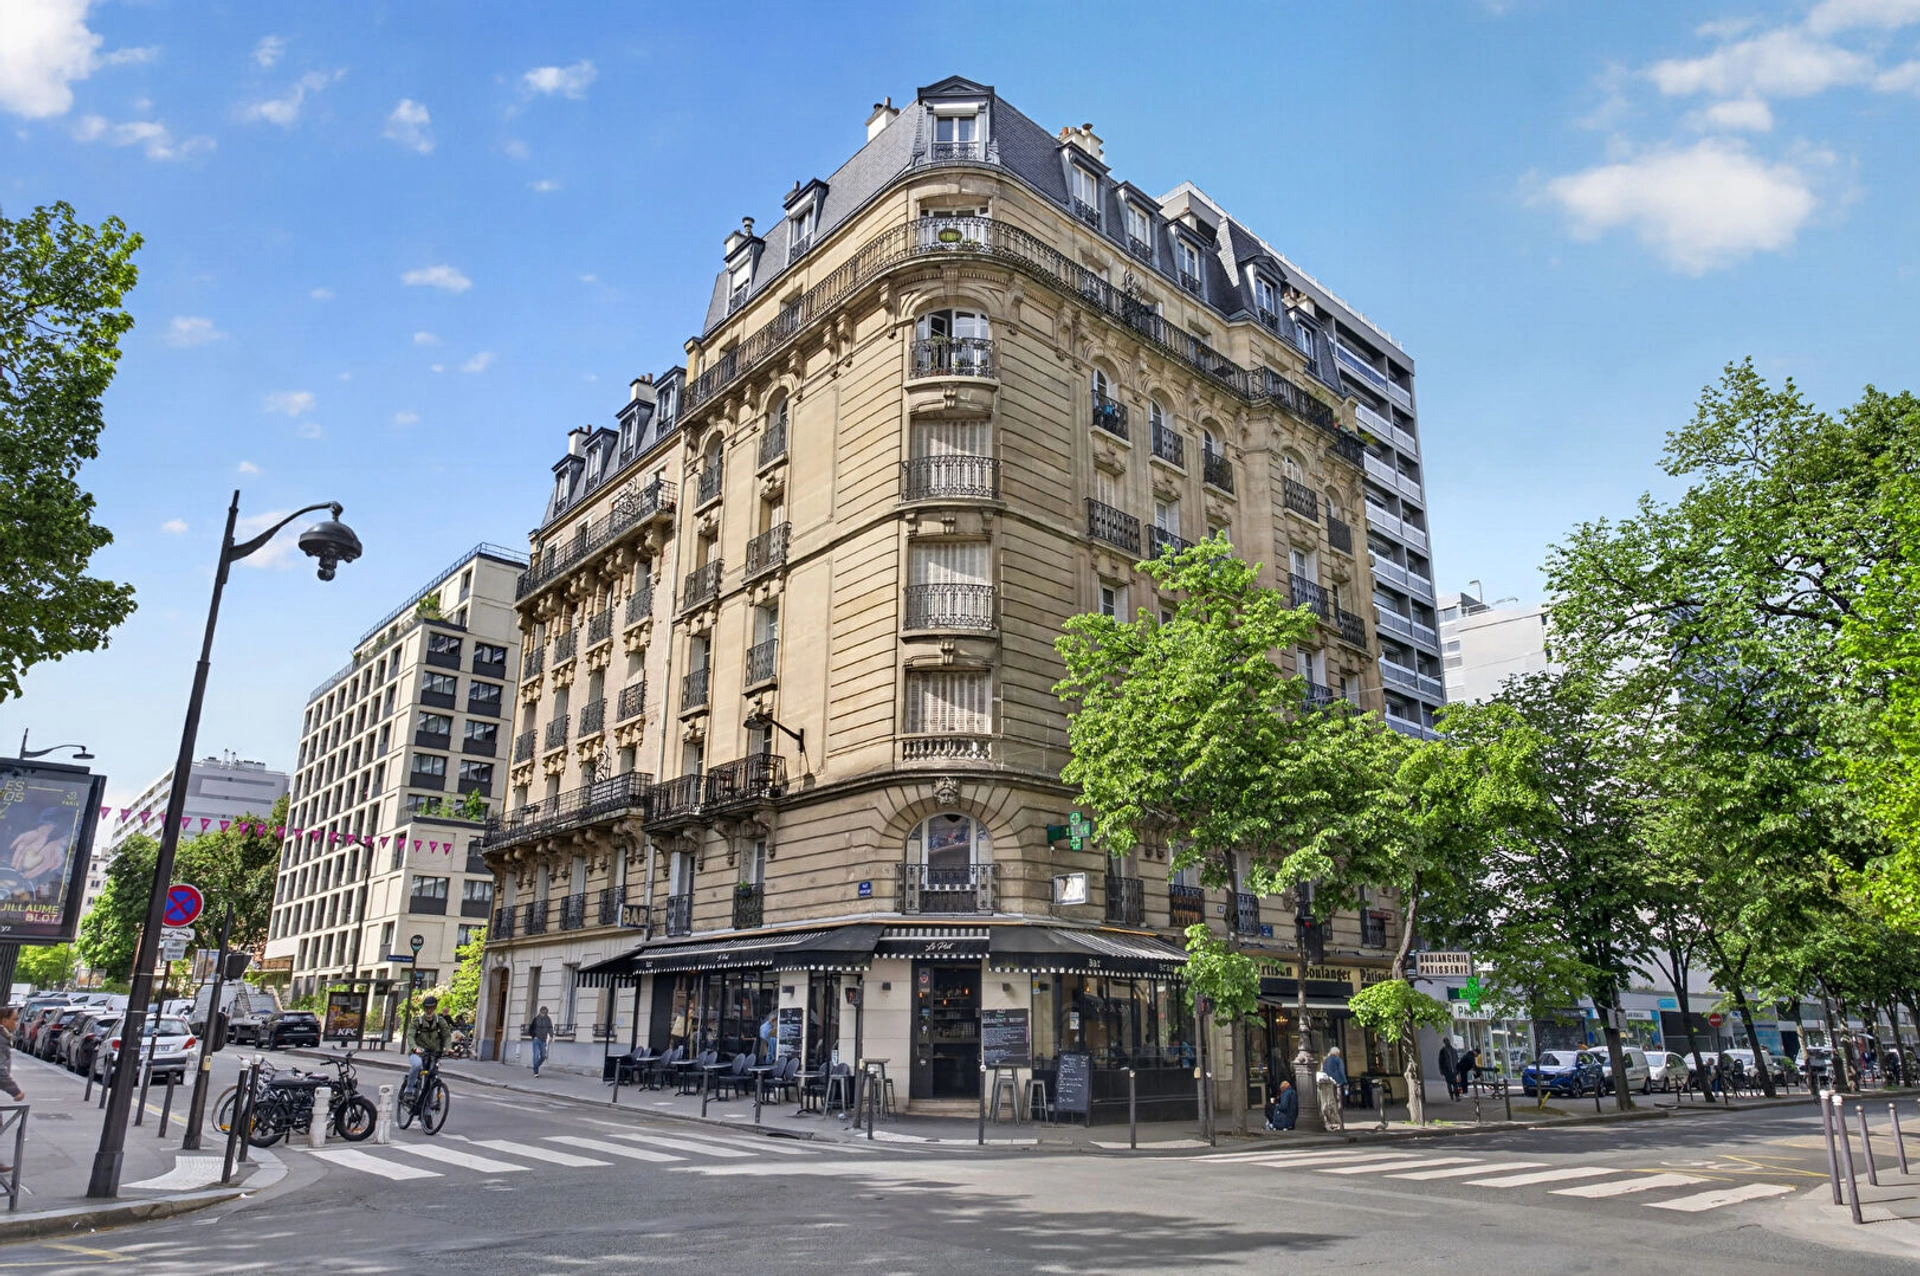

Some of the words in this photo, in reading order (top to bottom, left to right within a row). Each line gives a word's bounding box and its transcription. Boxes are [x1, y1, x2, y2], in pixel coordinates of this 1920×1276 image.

[25, 913, 58, 923] BLOT
[623, 907, 649, 926] BAR
[1419, 954, 1467, 963] BOULANGERIE
[1420, 965, 1469, 975] PATISSERIE
[337, 1028, 359, 1036] KFC
